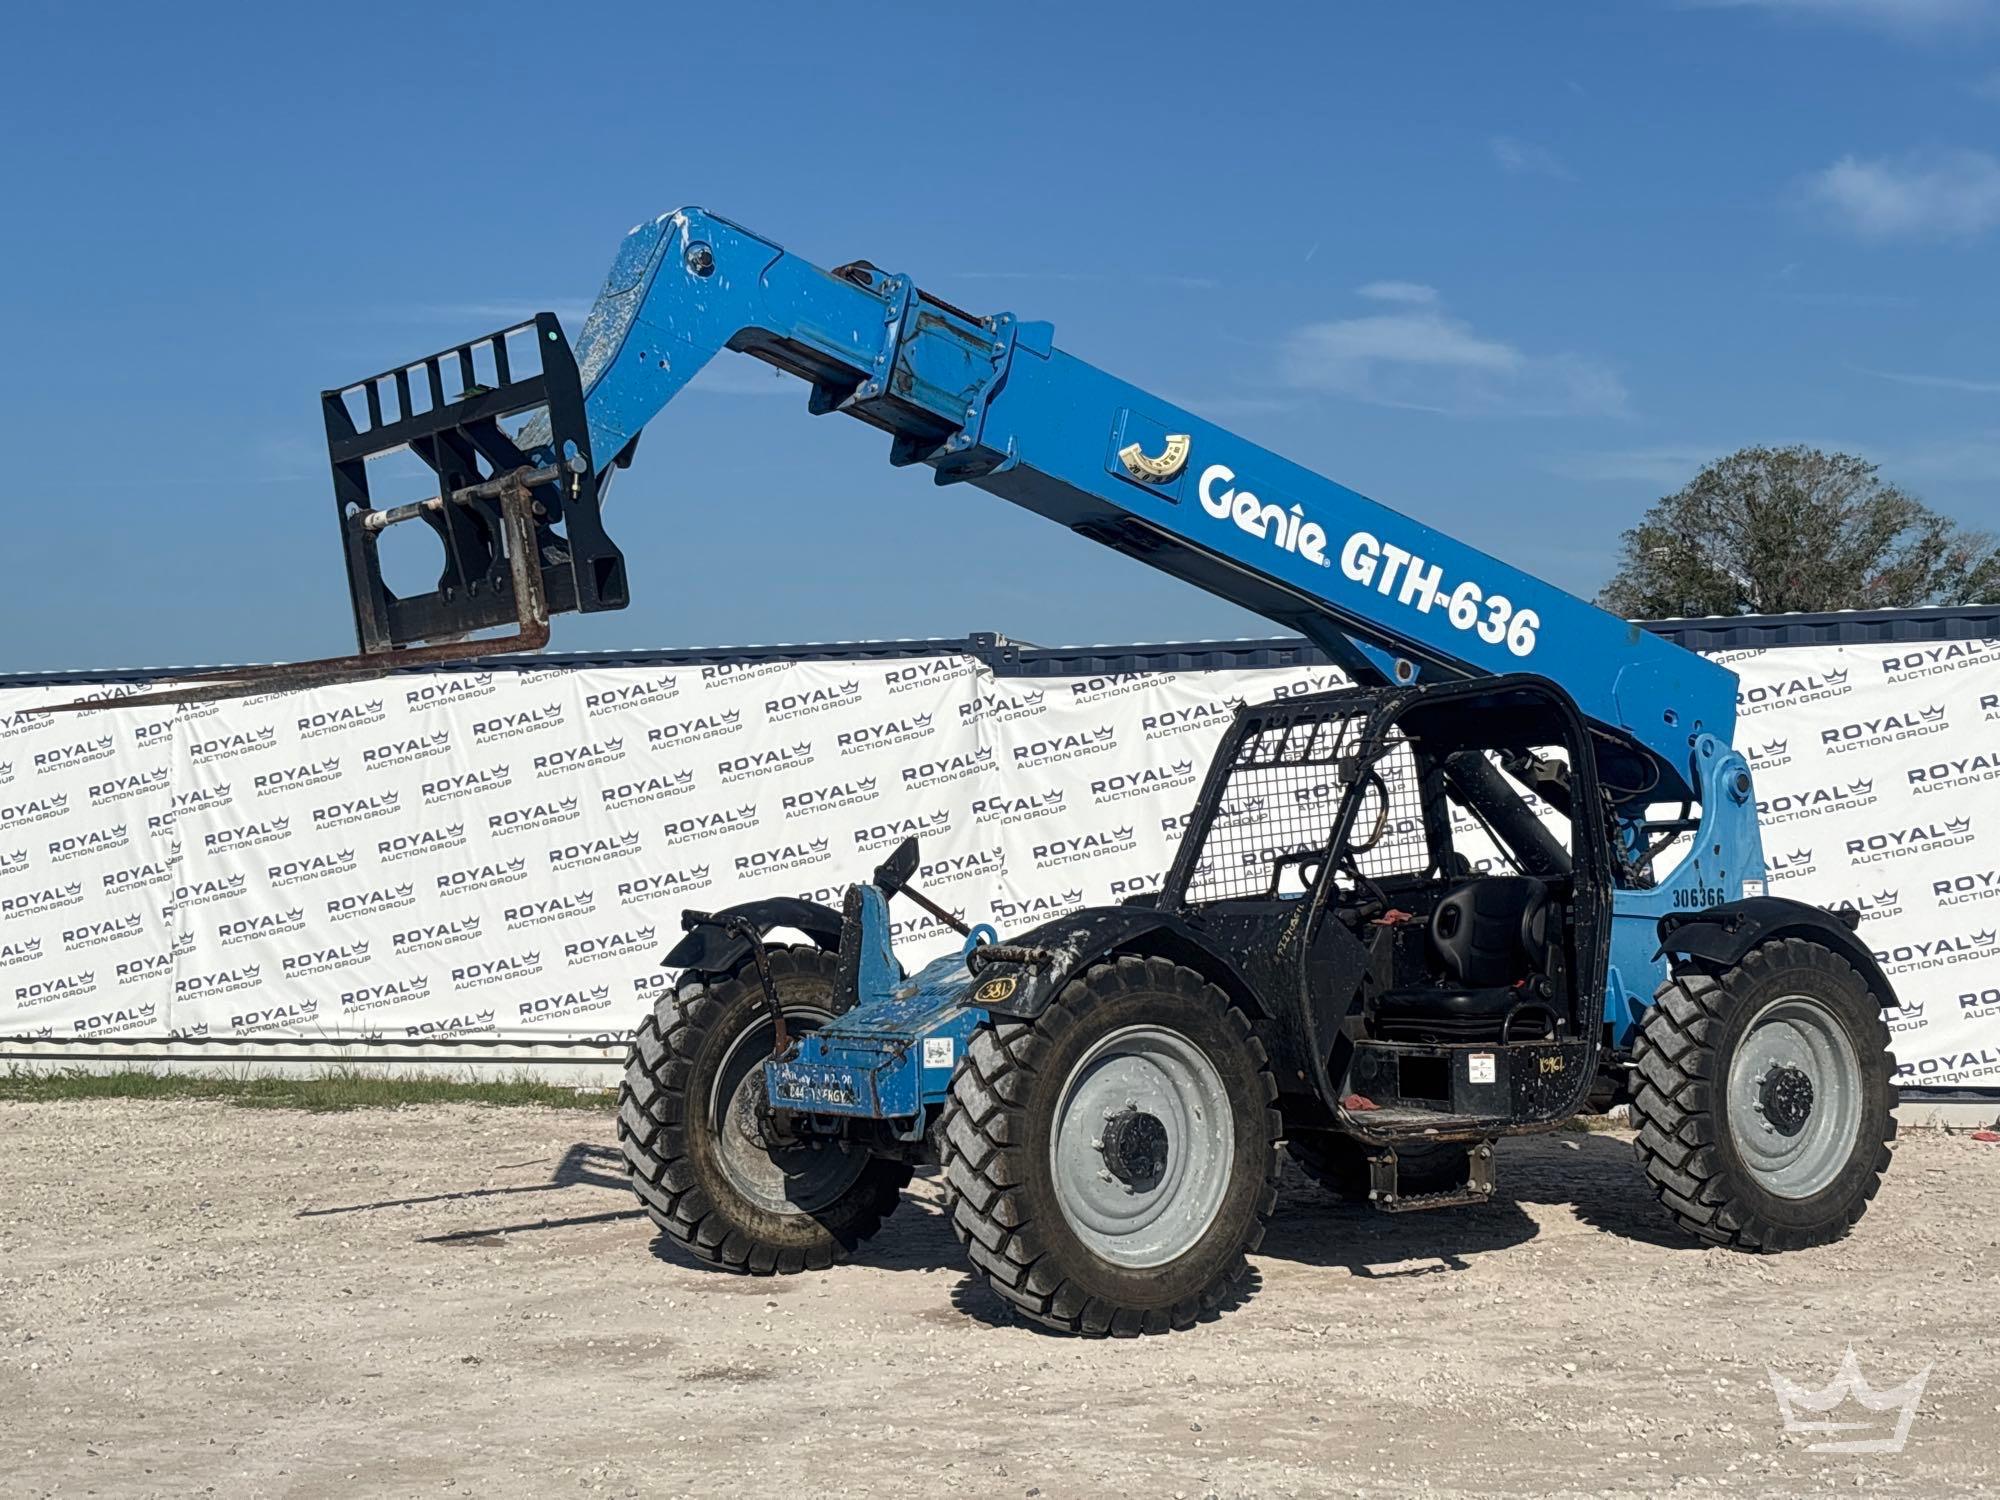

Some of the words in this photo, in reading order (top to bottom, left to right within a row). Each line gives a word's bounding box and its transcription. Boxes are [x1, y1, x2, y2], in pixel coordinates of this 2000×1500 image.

[1198, 464, 1328, 567] Genie
[1340, 531, 1540, 657] GTH-636
[1882, 640, 1982, 673] ROYAL
[704, 673, 755, 690] AUCTION
[884, 657, 961, 685] ROYAL
[1887, 663, 1954, 684] AUCTION
[406, 678, 475, 705] ROYAL
[585, 682, 659, 709] ROYAL
[888, 676, 940, 694] AUCTION
[1075, 687, 1130, 705] AUCTION
[1132, 675, 1176, 692] GROUP
[409, 696, 456, 713] AUCTION
[458, 686, 495, 702] GROUP
[589, 700, 639, 717] AUCTION
[640, 690, 679, 705] GROUP
[764, 687, 841, 714] ROYAL
[768, 705, 820, 723] AUCTION
[821, 695, 862, 711] GROUP
[297, 705, 366, 731] ROYAL
[300, 723, 347, 740] AUCTION
[348, 713, 386, 728] GROUP
[472, 709, 544, 736] ROYAL
[647, 715, 722, 743] ROYAL
[1141, 702, 1222, 731] ROYAL
[1821, 713, 1921, 745] ROYAL
[476, 728, 524, 745] AUCTION
[526, 717, 564, 733] GROUP
[651, 734, 701, 751] AUCTION
[703, 724, 743, 739] GROUP
[837, 719, 914, 747] ROYAL
[841, 738, 892, 756] AUCTION
[894, 727, 935, 744] GROUP
[1145, 722, 1200, 740] AUCTION
[1826, 735, 1893, 755] AUCTION
[1896, 722, 1949, 741] GROUP
[34, 741, 98, 767] ROYAL
[363, 737, 432, 763] ROYAL
[366, 755, 413, 771] AUCTION
[414, 745, 452, 760] GROUP
[533, 743, 605, 770] ROYAL
[1013, 732, 1094, 761] ROYAL
[1017, 752, 1072, 770] AUCTION
[1073, 741, 1117, 757] GROUP
[37, 758, 81, 775] AUCTION
[81, 748, 116, 763] GROUP
[537, 761, 586, 778] AUCTION
[587, 751, 626, 767] GROUP
[718, 748, 793, 775] ROYAL
[721, 767, 772, 784] AUCTION
[774, 756, 815, 772] GROUP
[902, 753, 978, 782] ROYAL
[254, 763, 323, 789] ROYAL
[257, 781, 304, 797] AUCTION
[305, 771, 343, 786] GROUP
[421, 770, 492, 796] ROYAL
[601, 776, 675, 802] ROYAL
[906, 773, 957, 791] AUCTION
[959, 761, 1000, 778] GROUP
[1092, 767, 1172, 795] ROYAL
[1912, 774, 1981, 795] AUCTION
[424, 788, 472, 805] AUCTION
[474, 778, 512, 794] GROUP
[605, 794, 655, 811] AUCTION
[656, 784, 696, 799] GROUP
[781, 783, 858, 810] ROYAL
[1094, 786, 1149, 804] AUCTION
[1151, 776, 1195, 792] GROUP
[312, 797, 381, 822] ROYAL
[488, 803, 560, 829] ROYAL
[785, 801, 837, 819] AUCTION
[838, 791, 879, 807] GROUP
[1824, 796, 1877, 813] GROUP
[315, 814, 362, 831] AUCTION
[364, 805, 401, 820] GROUP
[491, 821, 540, 837] AUCTION
[541, 811, 580, 826] GROUP
[663, 810, 738, 837] ROYAL
[854, 817, 931, 844] ROYAL
[48, 830, 112, 855] ROYAL
[377, 829, 447, 854] ROYAL
[667, 829, 718, 846] AUCTION
[719, 819, 759, 834] GROUP
[1846, 824, 1946, 855] ROYAL
[52, 847, 95, 863] AUCTION
[96, 837, 130, 852] GROUP
[381, 847, 428, 863] AUCTION
[429, 837, 467, 852] GROUP
[549, 837, 621, 863] ROYAL
[552, 855, 601, 872] AUCTION
[603, 845, 642, 861] GROUP
[734, 844, 810, 870] ROYAL
[1032, 832, 1113, 860] ROYAL
[1036, 851, 1091, 869] AUCTION
[1093, 841, 1137, 857] GROUP
[1851, 846, 1918, 866] AUCTION
[1921, 834, 1975, 852] GROUP
[268, 854, 338, 879] ROYAL
[271, 872, 319, 888] AUCTION
[320, 863, 358, 877] GROUP
[436, 863, 508, 889] ROYAL
[738, 862, 789, 879] AUCTION
[791, 852, 831, 868] GROUP
[921, 851, 991, 879] ROYAL
[439, 881, 488, 897] AUCTION
[489, 872, 528, 887] GROUP
[617, 871, 691, 896] ROYAL
[621, 888, 671, 905] AUCTION
[672, 879, 712, 894] GROUP
[922, 870, 970, 888] AUCTION
[1, 887, 66, 912] ROYAL
[4, 904, 48, 920] AUCTION
[49, 895, 84, 910] GROUP
[327, 888, 396, 914] ROYAL
[330, 906, 377, 922] AUCTION
[378, 897, 416, 912] GROUP
[504, 896, 576, 922] ROYAL
[1673, 888, 1725, 908] 306366
[62, 919, 126, 943] ROYAL
[507, 914, 556, 931] AUCTION
[557, 905, 596, 920] GROUP
[65, 936, 108, 952] AUCTION
[109, 927, 144, 941] GROUP
[392, 921, 462, 947] ROYAL
[395, 939, 443, 955] AUCTION
[444, 930, 482, 945] GROUP
[564, 931, 637, 957] ROYAL
[282, 946, 352, 971] ROYAL
[567, 950, 617, 966] AUCTION
[618, 940, 657, 955] GROUP
[285, 964, 333, 979] AUCTION
[334, 955, 372, 969] GROUP
[451, 957, 523, 982] ROYAL
[454, 975, 503, 991] AUCTION
[504, 965, 543, 980] GROUP
[15, 976, 79, 1000] ROYAL
[17, 993, 61, 1009] AUCTION
[62, 984, 97, 999] GROUP
[340, 981, 411, 1006] ROYAL
[344, 999, 391, 1014] AUCTION
[392, 990, 430, 1004] GROUP
[518, 991, 591, 1016] ROYAL
[522, 1008, 571, 1024] AUCTION
[572, 999, 612, 1014] GROUP
